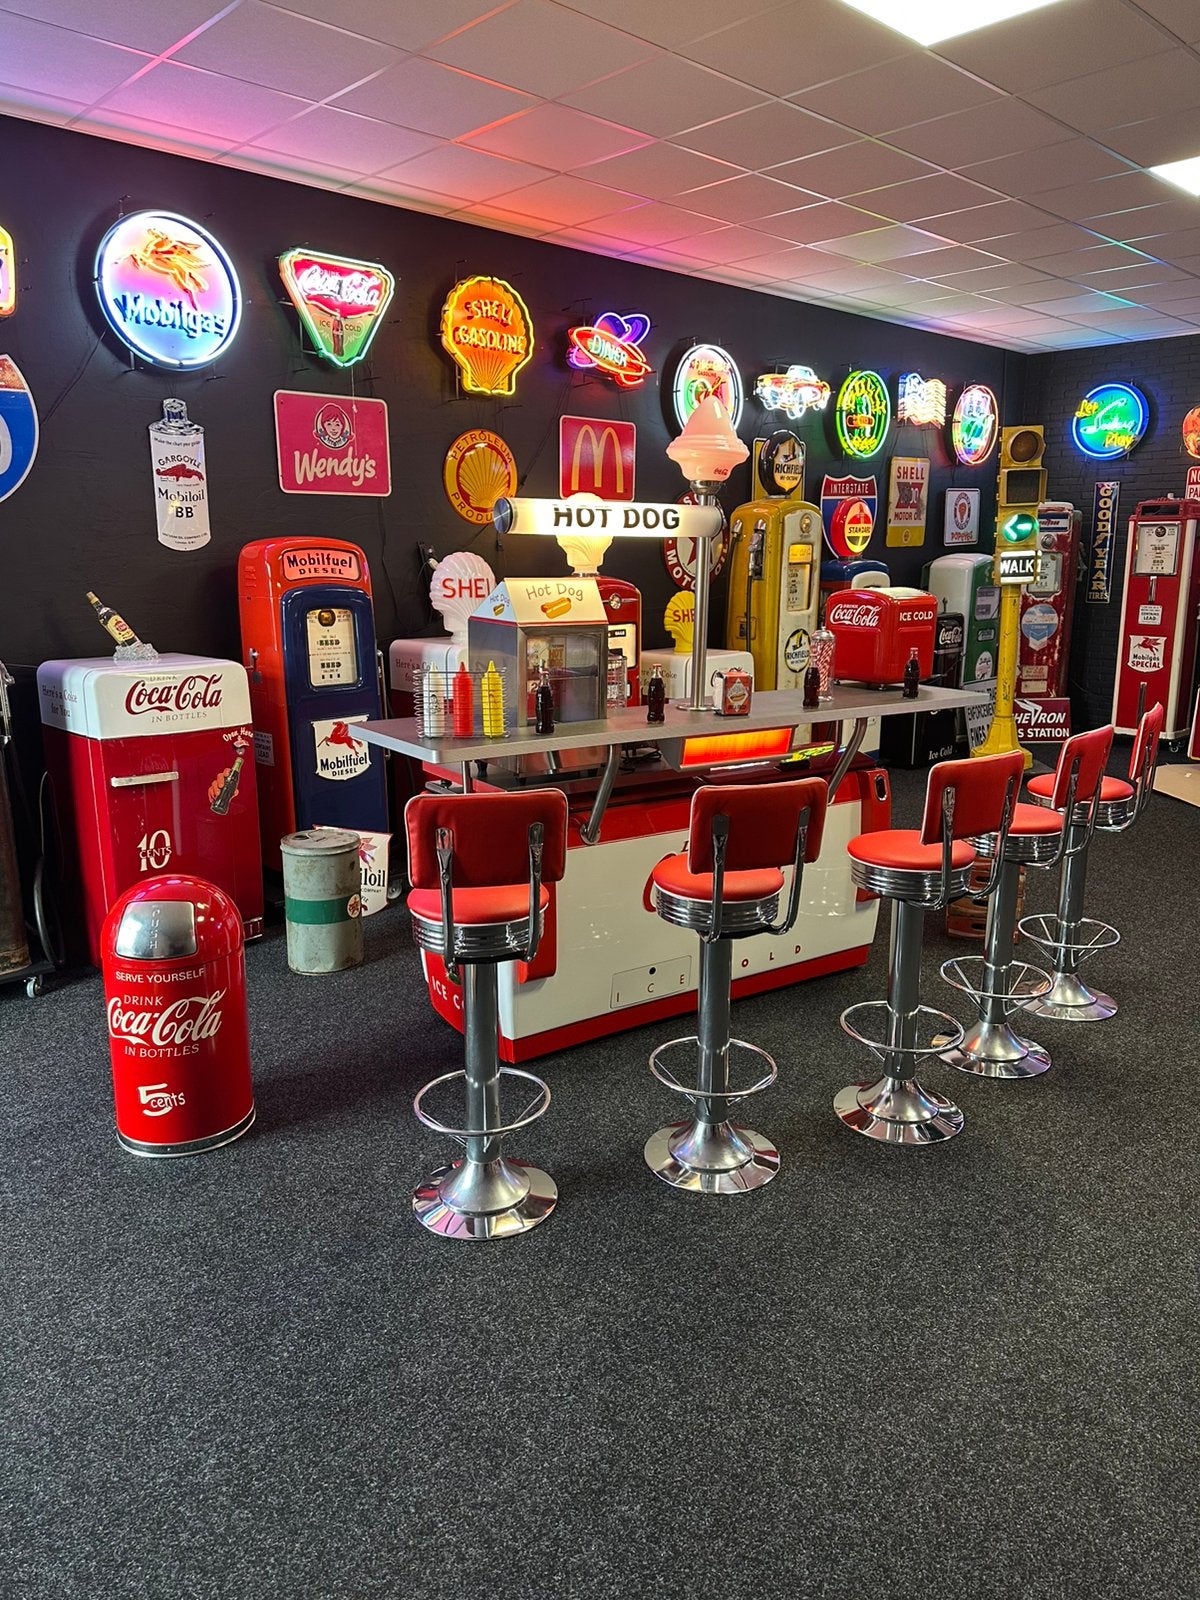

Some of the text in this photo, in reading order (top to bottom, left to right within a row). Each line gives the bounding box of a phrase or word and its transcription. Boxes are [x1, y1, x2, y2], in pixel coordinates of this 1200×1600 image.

[116, 292, 225, 337] Mobilgas
[466, 300, 513, 327] SHELL
[320, 320, 361, 332] ICE COLD
[454, 325, 526, 355] GASOLINE
[590, 336, 628, 367] DINER
[451, 431, 513, 464] PETROLEUM
[158, 454, 201, 468] GARGOYLE
[294, 447, 376, 487] Wendy's
[774, 463, 802, 475] RICHFIEL
[897, 466, 924, 480] SHELL
[1190, 470, 1200, 483] N
[158, 487, 205, 502] Mobiloil
[831, 483, 869, 494] INTERSTATE
[451, 493, 494, 523] PRODU
[553, 506, 680, 530] HOT DOG
[894, 512, 912, 520] MOTOR
[848, 526, 871, 534] STANDARD
[1093, 486, 1112, 591] GOODYEAR
[287, 553, 352, 570] Mobilfuel
[1000, 559, 1034, 574] WALK
[299, 567, 344, 576] DIESEL
[666, 549, 697, 591] MOT
[442, 577, 489, 599] SHE
[526, 583, 583, 601] Hot Dog
[1088, 592, 1110, 600] TIRES
[672, 608, 694, 623] SHE
[830, 603, 882, 627] Coca-Cola
[900, 610, 934, 622] ICE COLD
[1131, 660, 1161, 669] SPECIAL
[1133, 653, 1160, 662] Mobilgas
[125, 673, 223, 715] Coca-Cola
[151, 711, 207, 723] IN BOTTLES
[968, 703, 995, 720] ENFORCEMEN
[1013, 712, 1065, 726] HEVRON
[222, 730, 239, 742] Open
[240, 727, 254, 738] Here
[1028, 728, 1070, 738] STATION
[928, 746, 953, 760] Ice Cold
[320, 753, 368, 771] Mobilfuel
[332, 767, 358, 777] DIESEL
[137, 830, 171, 871] 10
[140, 847, 172, 859] CENTS
[360, 867, 385, 887] iloil
[115, 967, 205, 984] SERVE YOURSELF
[432, 976, 448, 1000] ICE
[124, 994, 164, 1006] DRINK
[107, 987, 227, 1047] Coca-Cola
[125, 1043, 200, 1058] IN BOTTLES
[137, 1083, 174, 1117] 5
[151, 1091, 186, 1109] cents
